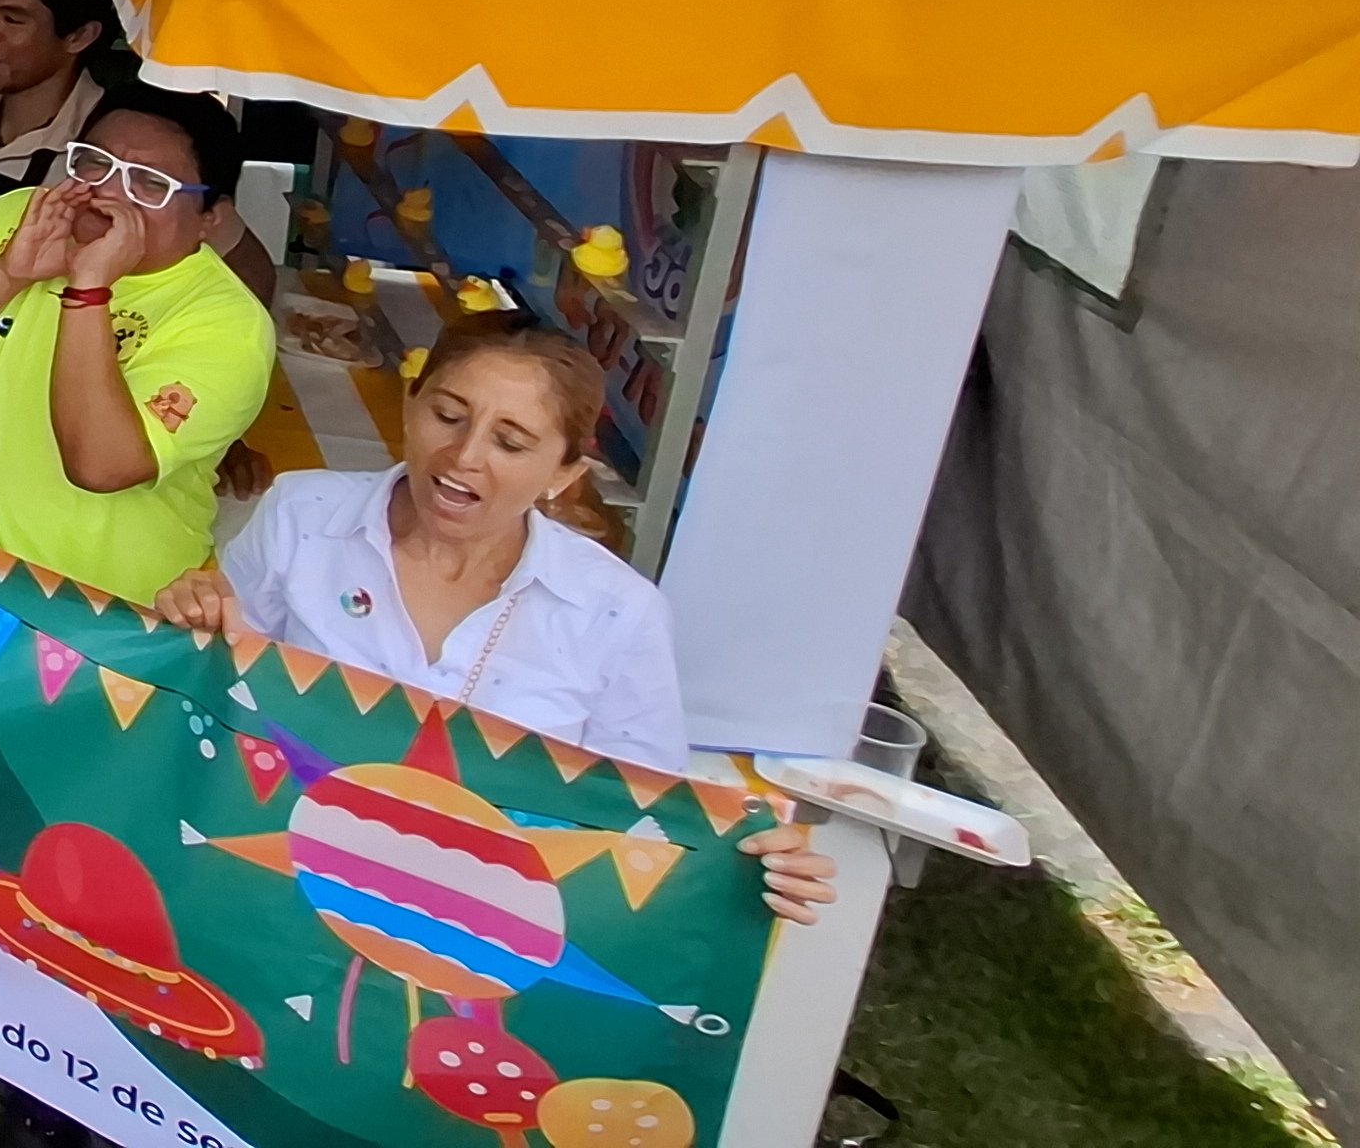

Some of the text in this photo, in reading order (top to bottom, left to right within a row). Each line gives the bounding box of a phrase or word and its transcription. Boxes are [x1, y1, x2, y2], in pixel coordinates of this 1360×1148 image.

[62, 1049, 100, 1093] 12
[112, 1084, 165, 1127] de
[177, 1120, 234, 1148] se
